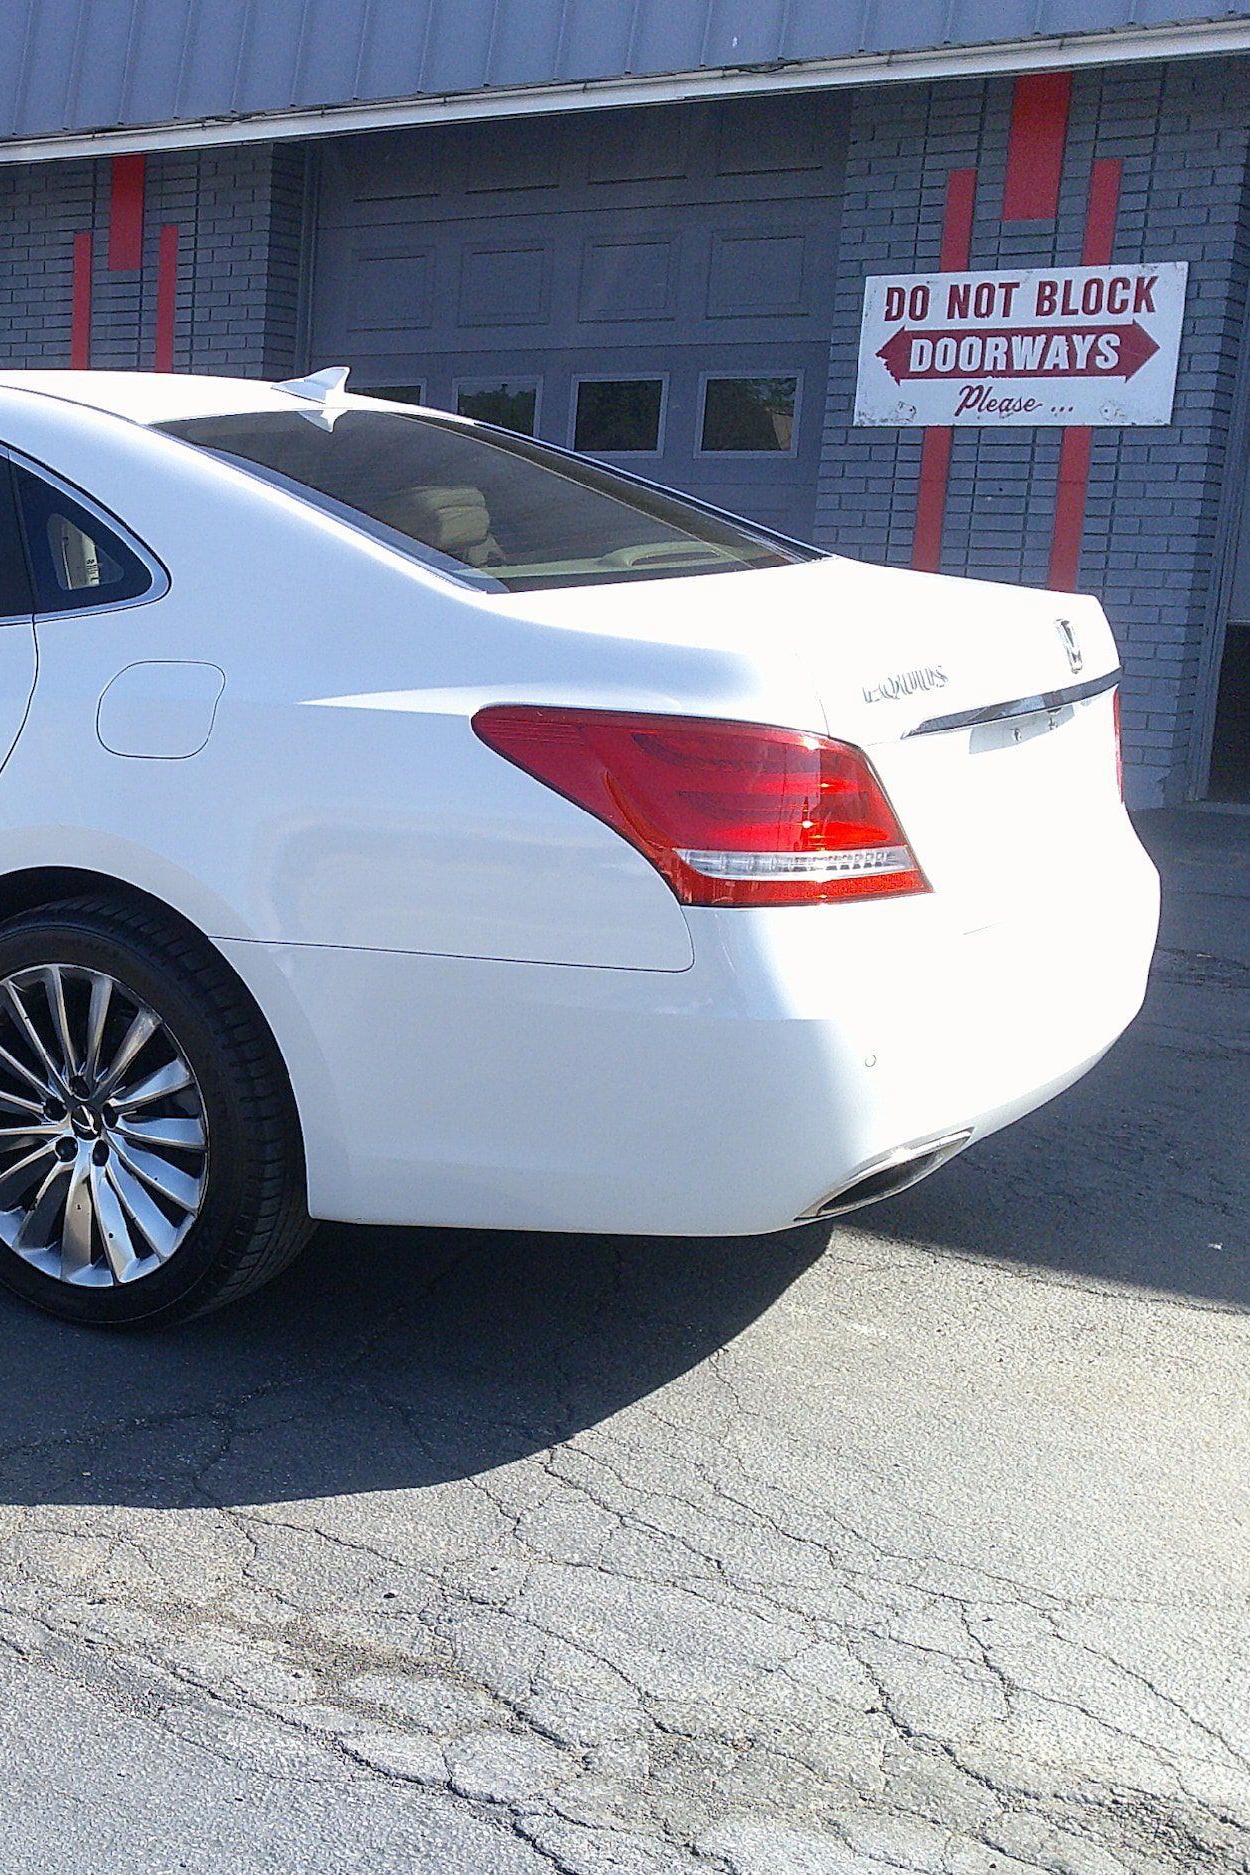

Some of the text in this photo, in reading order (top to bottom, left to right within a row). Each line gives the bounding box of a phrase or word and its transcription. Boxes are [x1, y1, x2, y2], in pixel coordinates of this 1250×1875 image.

[884, 275, 1160, 322] DO NOT BLOCK
[908, 333, 1122, 373] DOORWAYS
[954, 384, 1043, 417] Please
